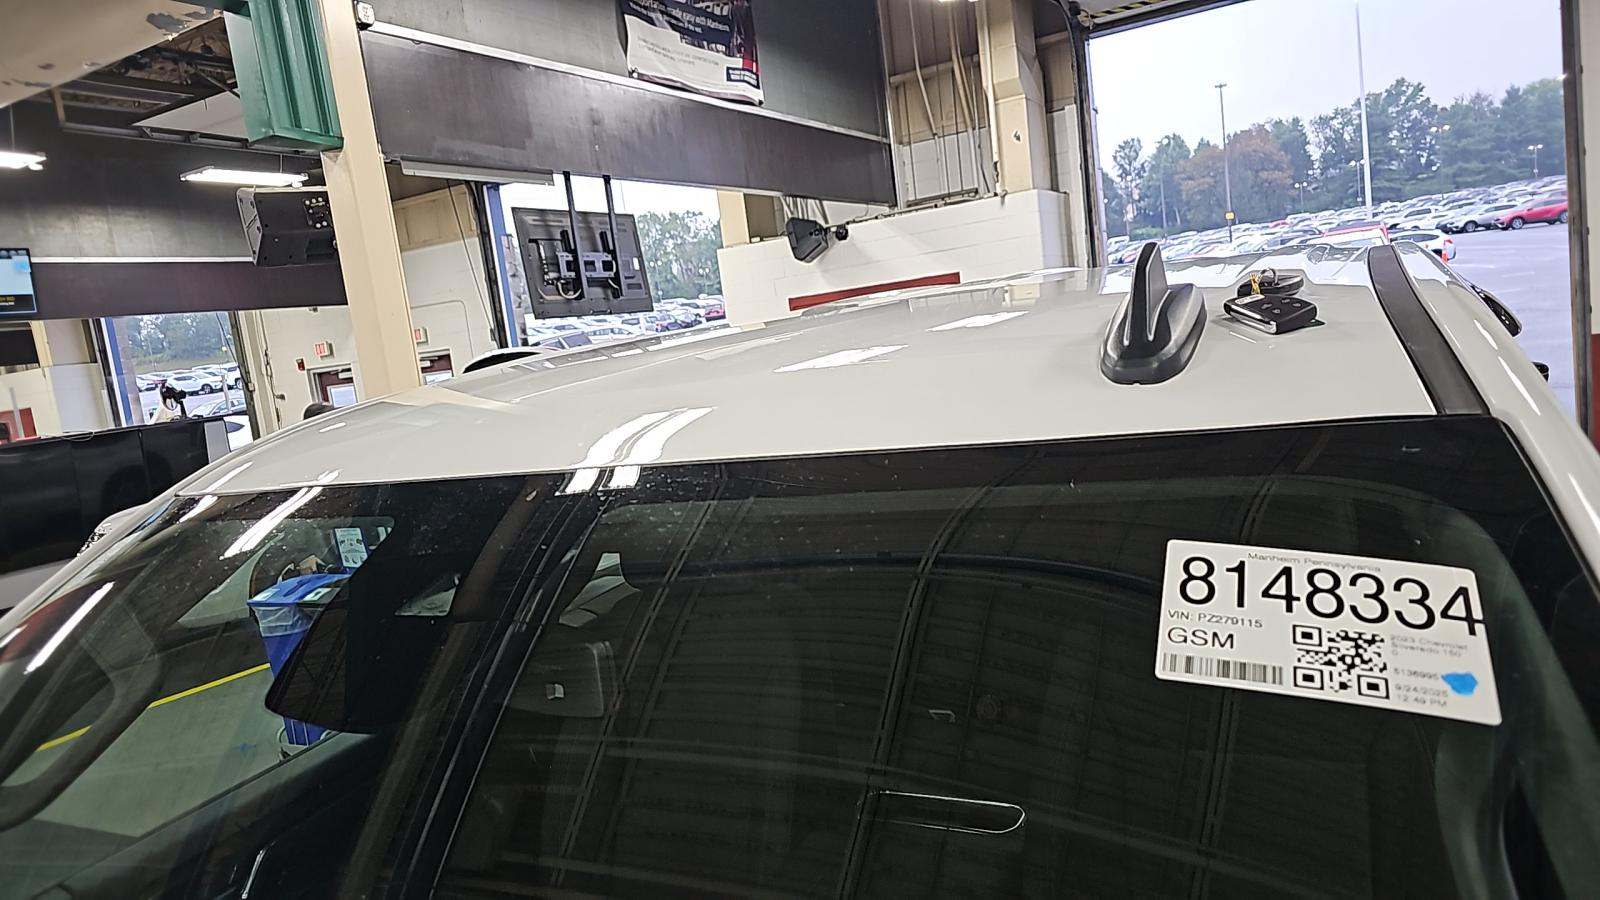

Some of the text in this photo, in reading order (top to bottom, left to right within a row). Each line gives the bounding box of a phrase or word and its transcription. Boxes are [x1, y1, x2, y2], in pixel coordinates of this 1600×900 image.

[1247, 553, 1382, 572] Manheim Pennsylvania
[1179, 556, 1486, 636] 8148334
[1168, 609, 1263, 629] VIN: PZ279115
[1167, 626, 1234, 649] GSM
